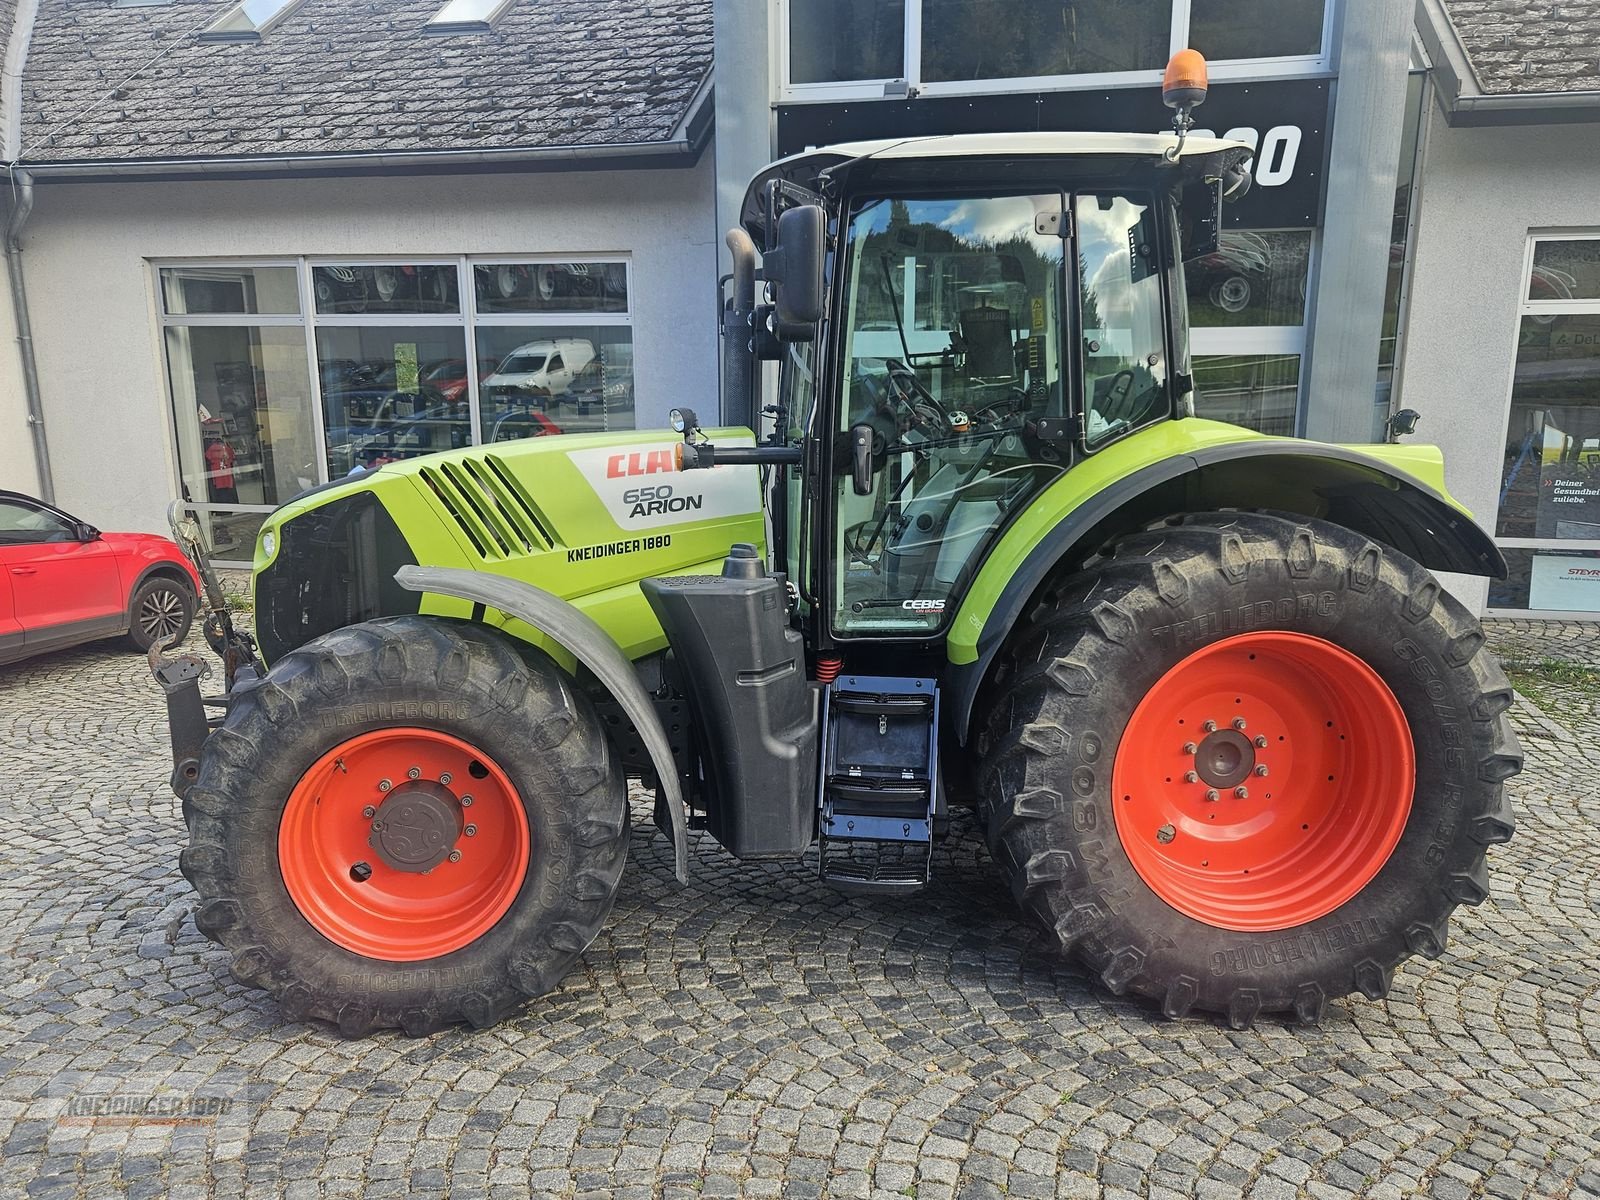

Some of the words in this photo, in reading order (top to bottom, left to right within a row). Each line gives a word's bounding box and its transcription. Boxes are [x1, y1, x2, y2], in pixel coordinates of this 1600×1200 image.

[623, 485, 673, 504] 650
[629, 494, 703, 518] ARION
[567, 540, 640, 562] KNEIDINGER
[642, 534, 671, 550] 1880
[1567, 568, 1600, 576] STEYR
[902, 599, 946, 610] CEBIS
[1151, 590, 1339, 650] TRELLEBORG
[319, 700, 471, 729] TRELLEBORG
[1208, 915, 1389, 975] TRELLEBORG
